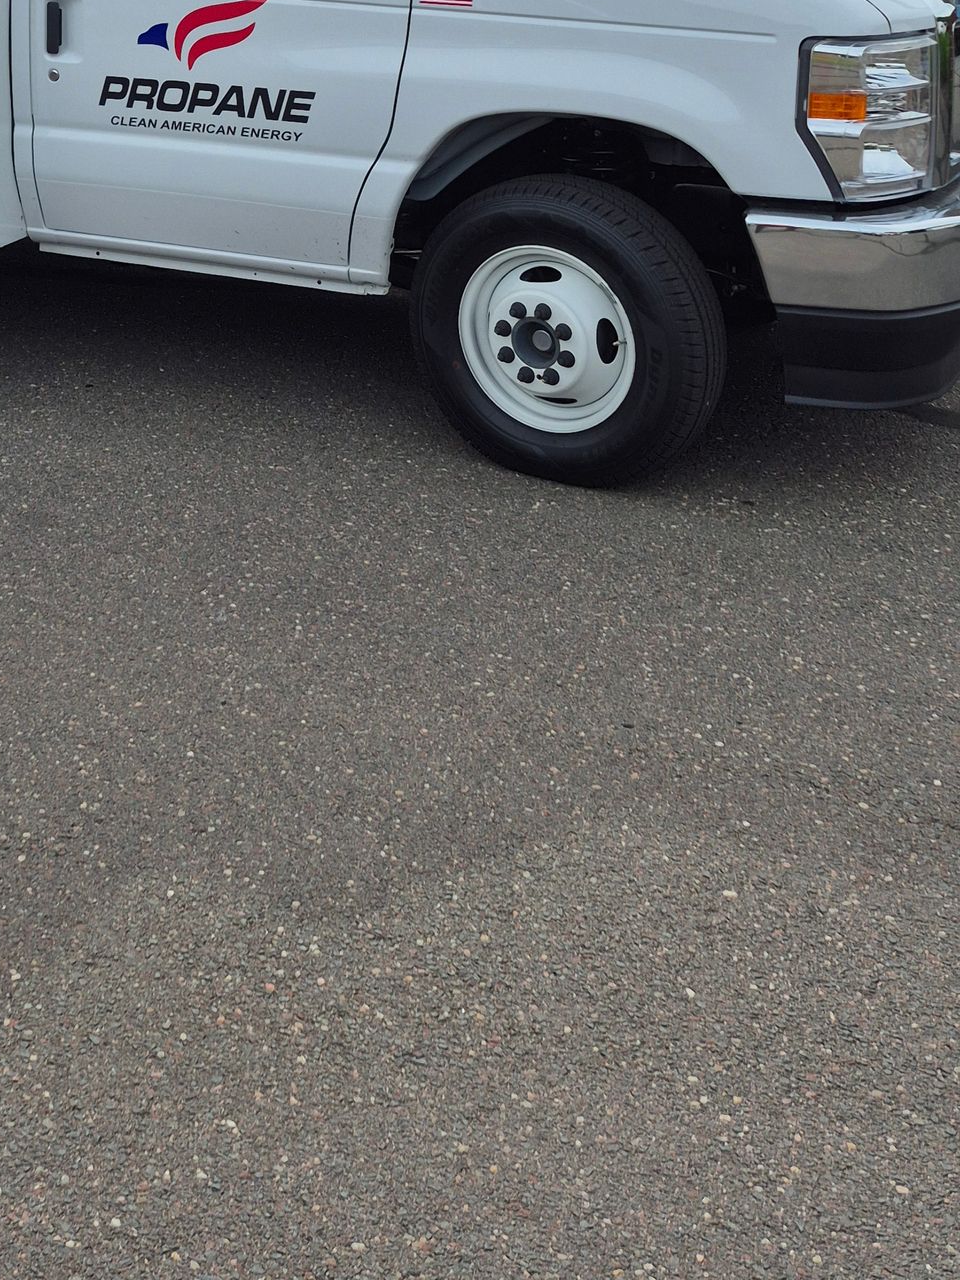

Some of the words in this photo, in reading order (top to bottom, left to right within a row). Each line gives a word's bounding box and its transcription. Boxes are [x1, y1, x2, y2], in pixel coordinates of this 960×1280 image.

[98, 75, 317, 124] PROPANE
[110, 115, 158, 129] CLEAN
[160, 120, 237, 136] AMERICAN
[240, 127, 303, 142] ENERGY
